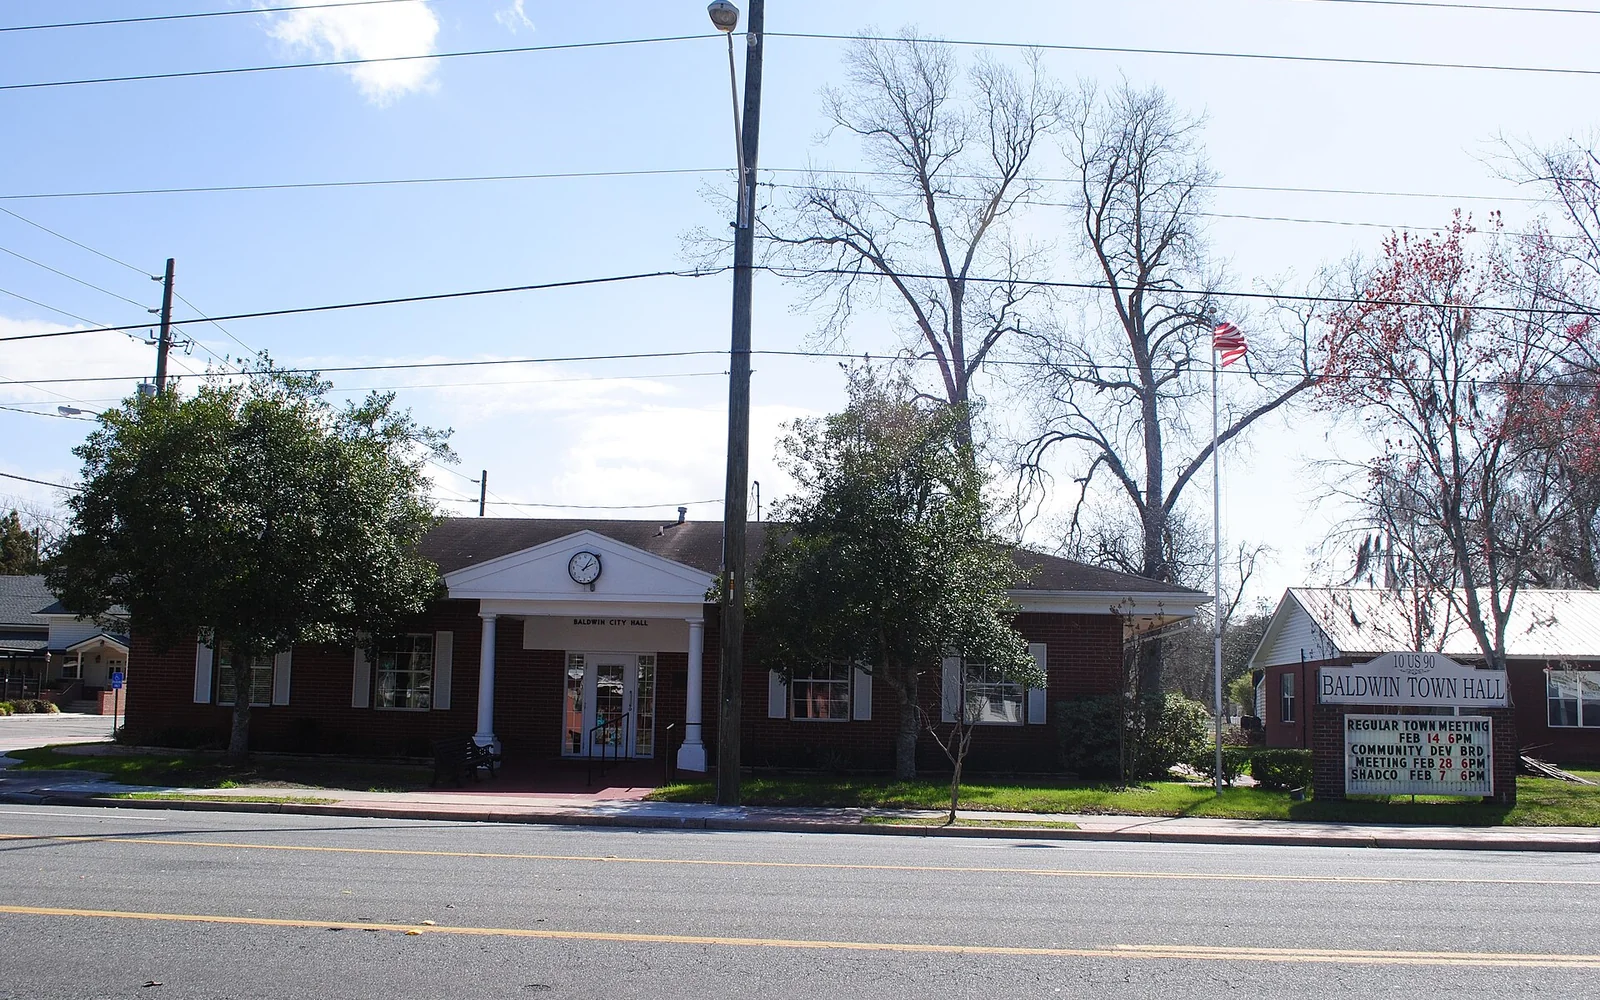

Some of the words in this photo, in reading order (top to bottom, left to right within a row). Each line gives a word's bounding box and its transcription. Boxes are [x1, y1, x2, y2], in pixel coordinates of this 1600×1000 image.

[1394, 654, 1404, 668] 10
[1408, 654, 1420, 668] US
[1424, 655, 1435, 669] 90
[1322, 674, 1400, 697] BALDWIN
[1406, 676, 1457, 698] TOWN
[1462, 678, 1505, 700] HALL
[1348, 720, 1398, 731] REGULAR
[1403, 720, 1436, 731] TOWN
[1439, 721, 1489, 732] MEETING
[1400, 733, 1420, 743] FEB
[1427, 733, 1440, 744] 14
[1448, 733, 1472, 744] 6PM
[1352, 744, 1422, 756] COMMUNITY
[1430, 745, 1452, 756] DEV
[1460, 746, 1484, 756] BRD
[1356, 757, 1407, 768] MEETING
[1414, 758, 1435, 768] FEB
[1439, 758, 1453, 769] 28
[1461, 758, 1485, 769] 6PM
[1352, 769, 1398, 780] SHADCO
[1410, 770, 1432, 781] FEB
[1439, 770, 1446, 781] 7
[1460, 770, 1485, 781] 6PM
